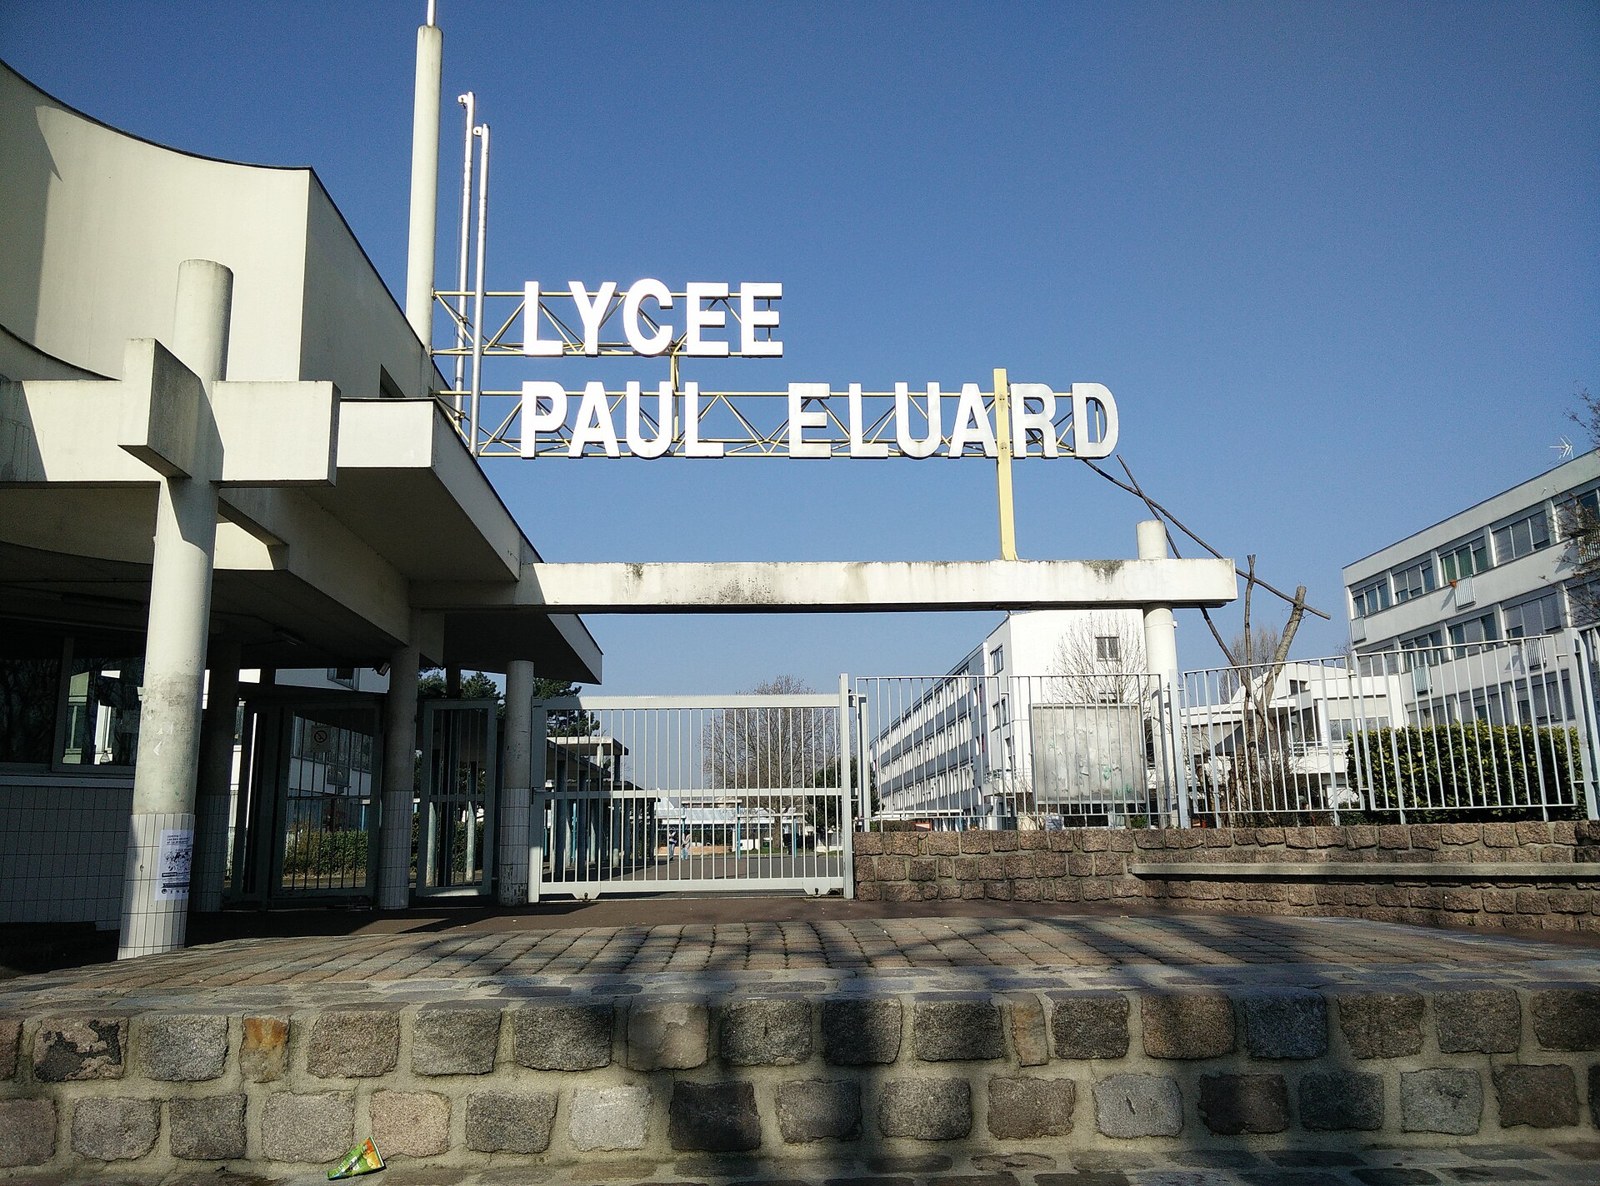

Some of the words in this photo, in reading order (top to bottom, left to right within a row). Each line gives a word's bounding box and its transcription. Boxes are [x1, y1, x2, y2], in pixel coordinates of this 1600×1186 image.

[524, 278, 783, 357] LYCEE
[521, 381, 724, 459] PAUL
[788, 382, 1119, 459] ELUARD
